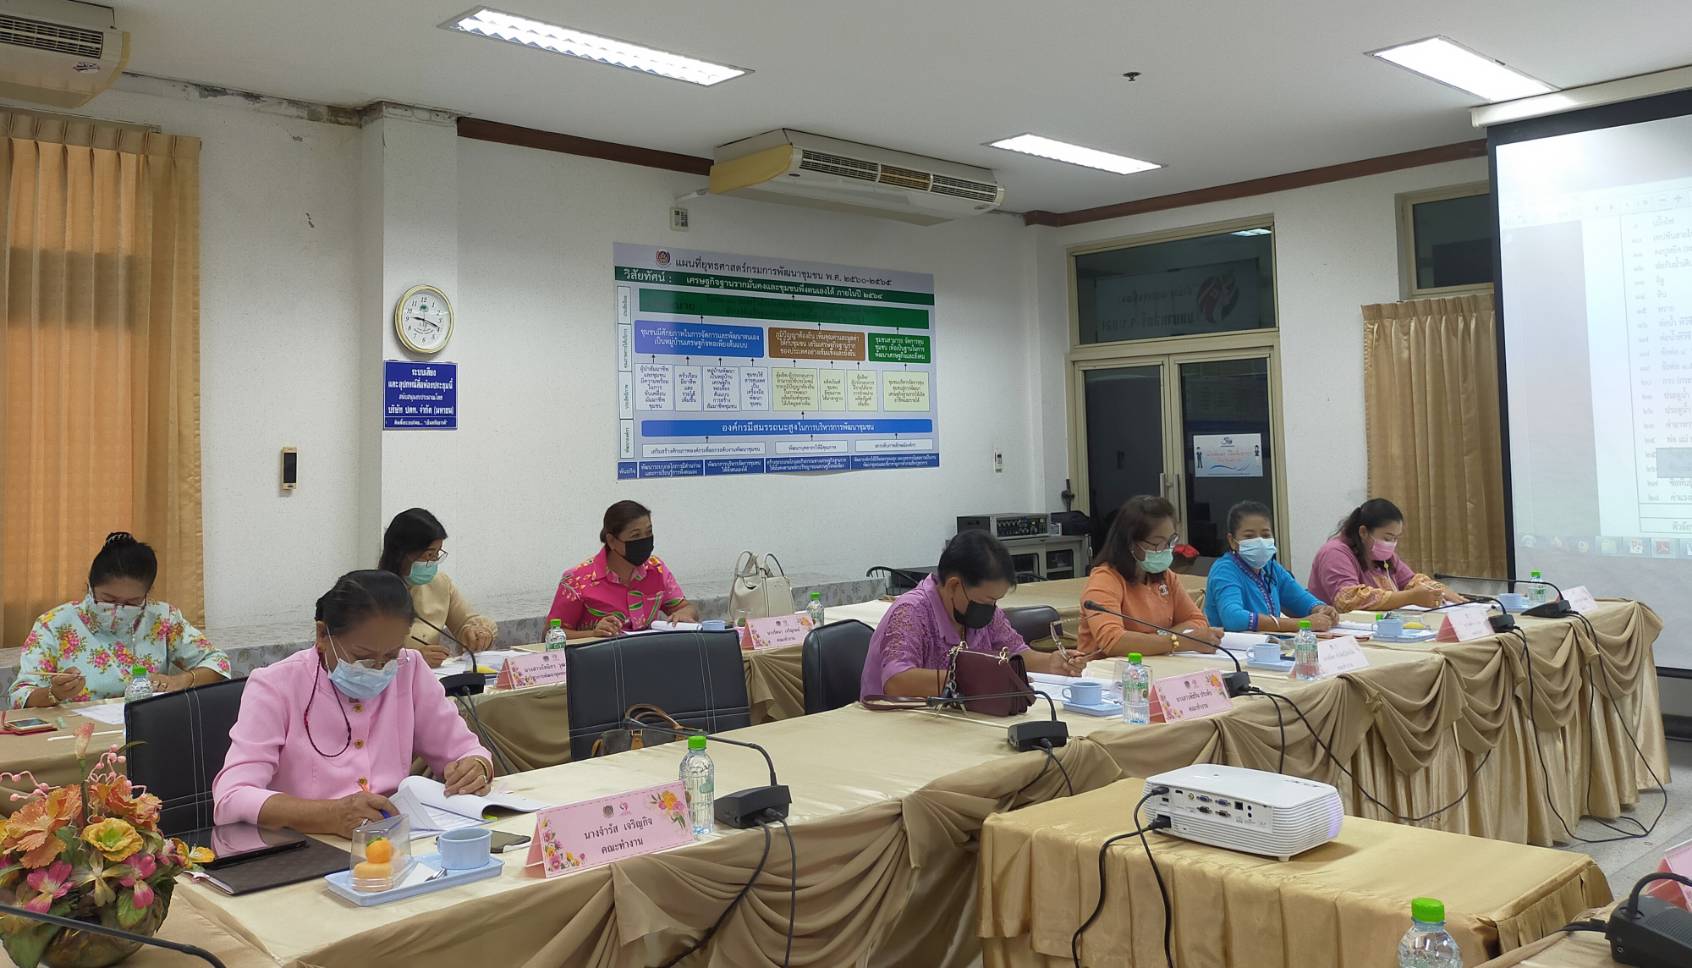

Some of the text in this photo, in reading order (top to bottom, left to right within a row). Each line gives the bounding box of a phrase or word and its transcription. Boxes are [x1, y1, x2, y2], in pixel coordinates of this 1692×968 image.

[623, 268, 666, 283] วิสัยทัศน์
[675, 256, 823, 281] แผนที่ยุทธศาสตร์กรมการพัฒนาชุมชน
[584, 816, 653, 840] นางจำรัส เจริญกิจ
[601, 838, 644, 855] คณะทำงาน
